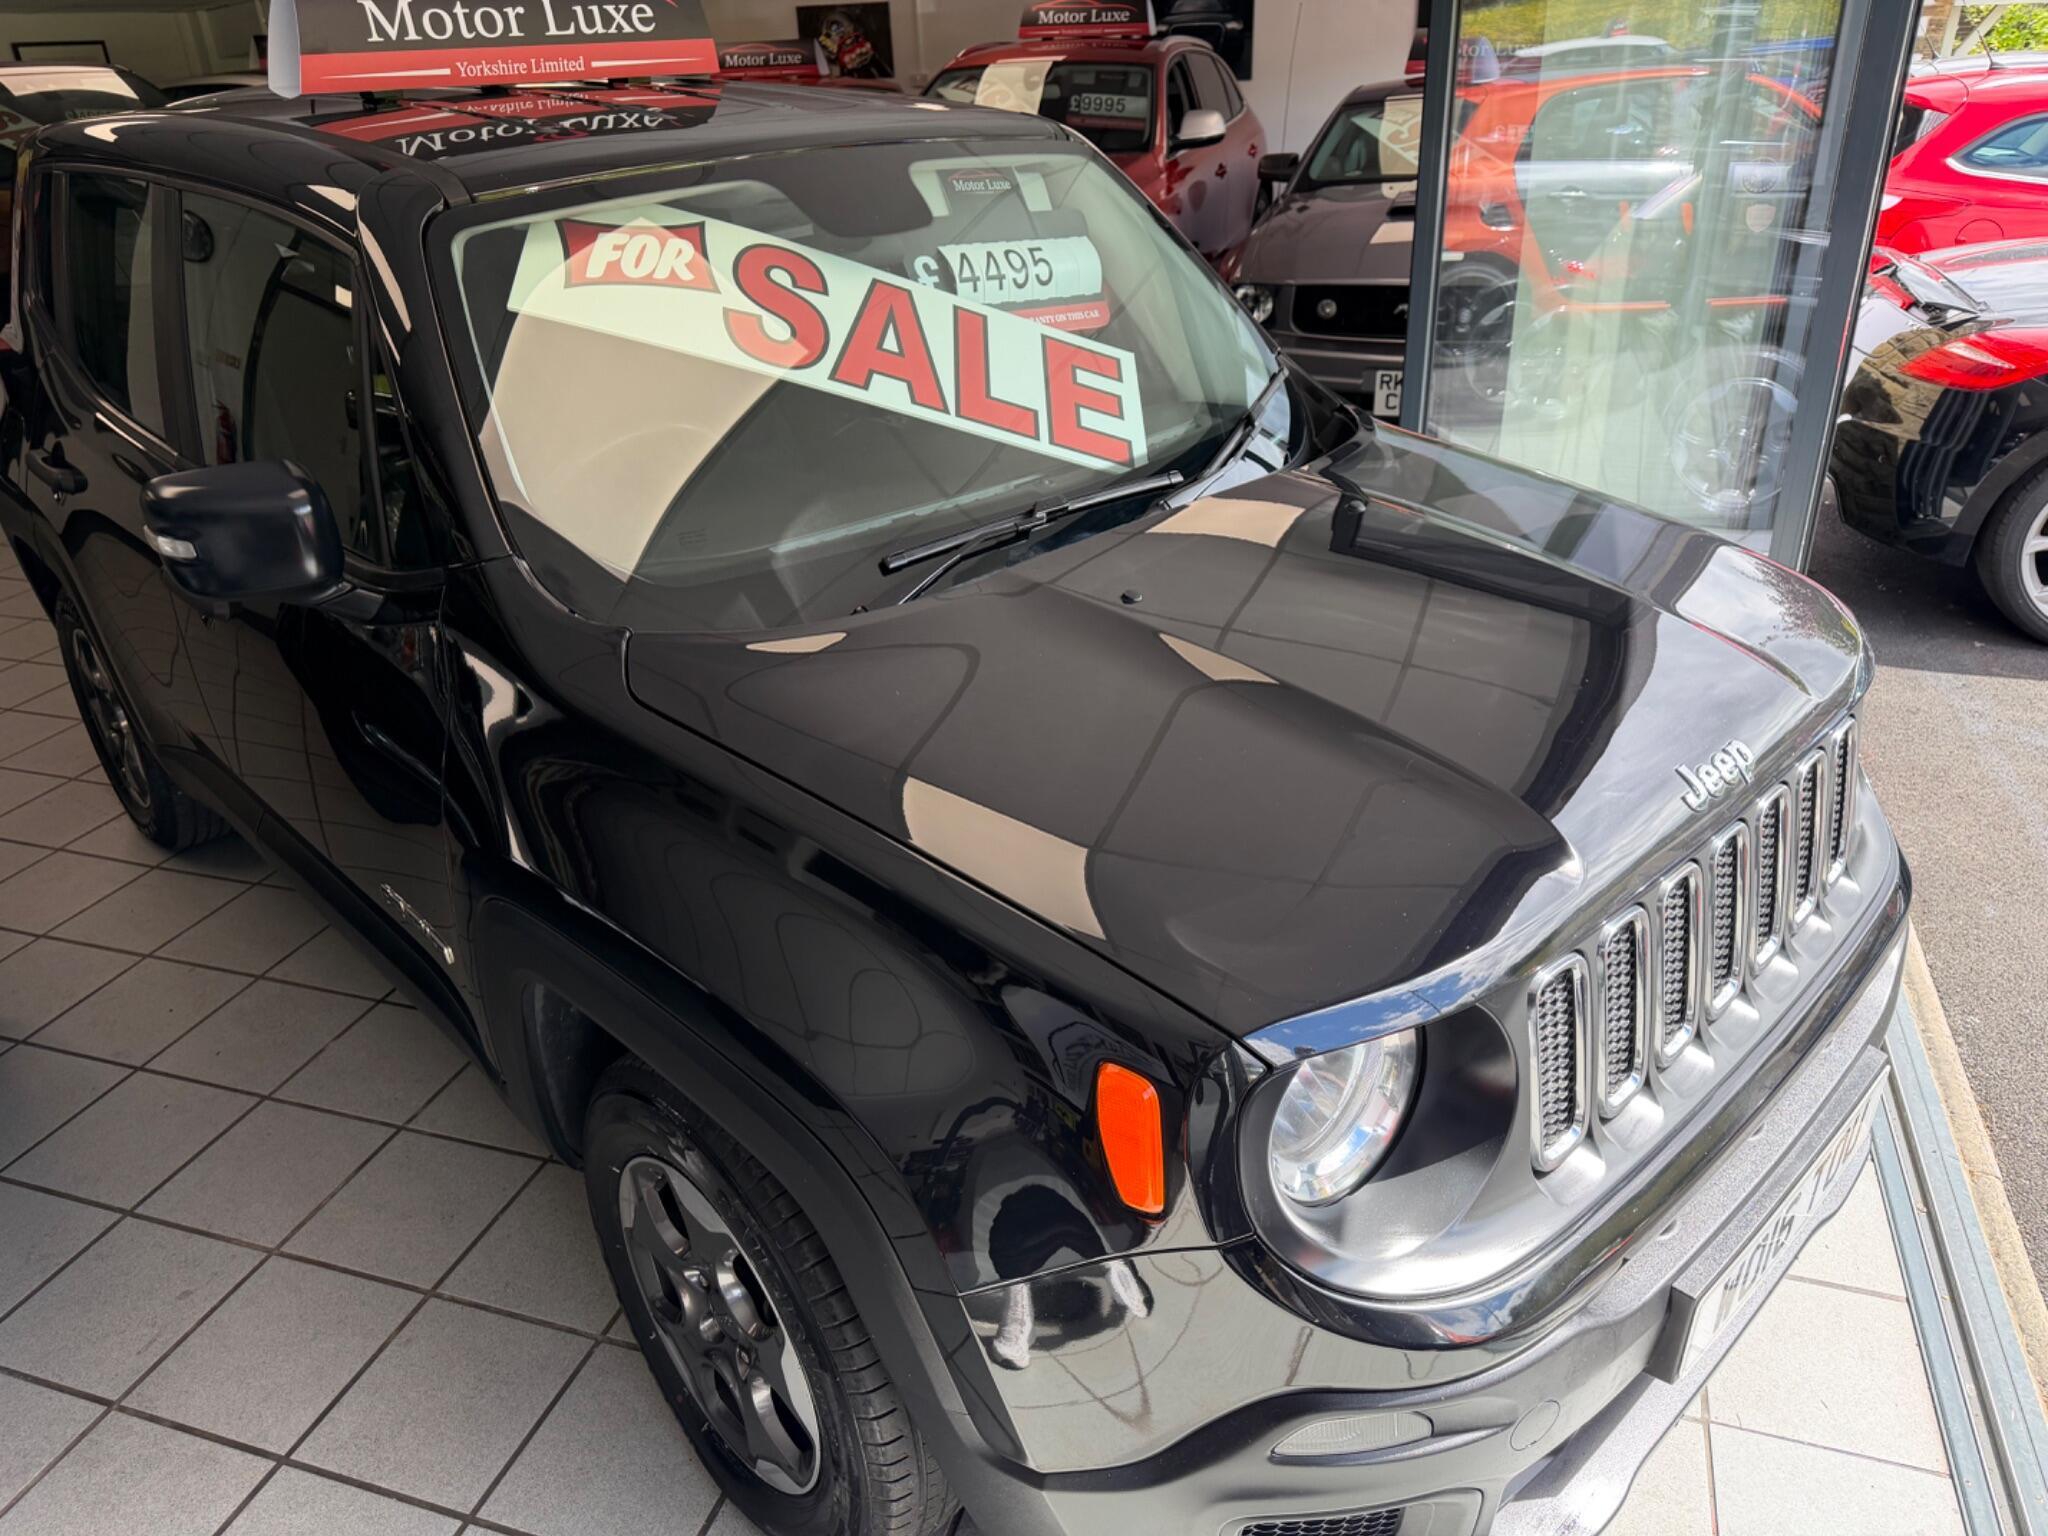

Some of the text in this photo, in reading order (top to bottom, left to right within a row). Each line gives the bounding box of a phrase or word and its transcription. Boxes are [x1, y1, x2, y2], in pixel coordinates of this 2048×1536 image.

[357, 0, 657, 42] Motor Luxe
[1038, 9, 1131, 24] Motor Luxe
[456, 57, 586, 80] Yorkshire Limited
[725, 52, 803, 68] Motor Luxe
[952, 178, 1012, 192] Motor Luxe
[584, 232, 1136, 468] FOR SALE
[1674, 740, 1754, 814] Jeep
